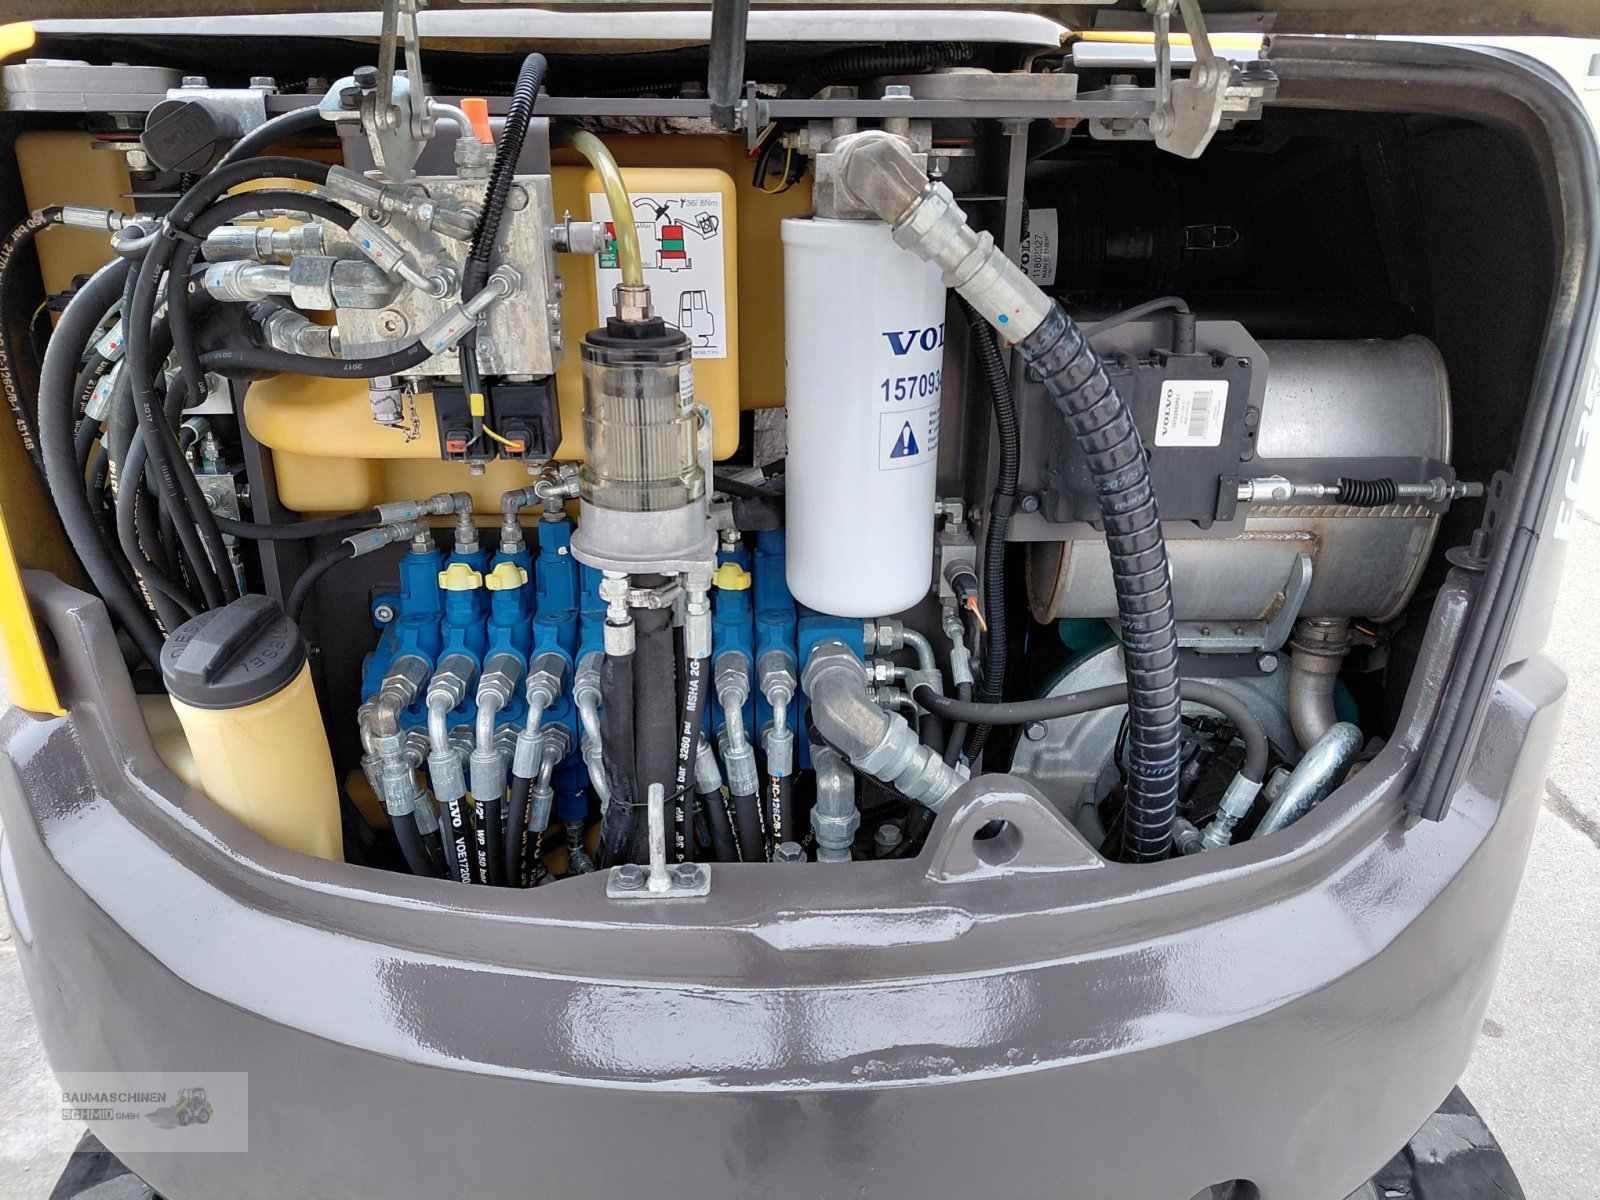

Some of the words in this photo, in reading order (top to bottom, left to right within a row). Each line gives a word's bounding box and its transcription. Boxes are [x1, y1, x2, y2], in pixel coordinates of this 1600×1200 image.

[10, 223, 28, 242] bar
[1033, 234, 1043, 278] 11802327
[152, 264, 162, 284] 2017
[343, 362, 363, 371] 2017
[142, 402, 153, 422] 2017
[1162, 388, 1173, 436] VOLVO
[16, 418, 35, 450] 43148
[109, 460, 120, 493] 43148
[170, 616, 209, 660] DIESE
[686, 679, 700, 712] MSHA
[683, 721, 692, 735] psi
[679, 736, 691, 760] 3260
[677, 765, 687, 783] bar
[475, 801, 484, 820] 1/2"
[675, 807, 685, 823] WP
[476, 829, 486, 846] WP
[455, 836, 471, 885] VOE17200
[478, 850, 487, 868] 350
[478, 868, 487, 885] bar
